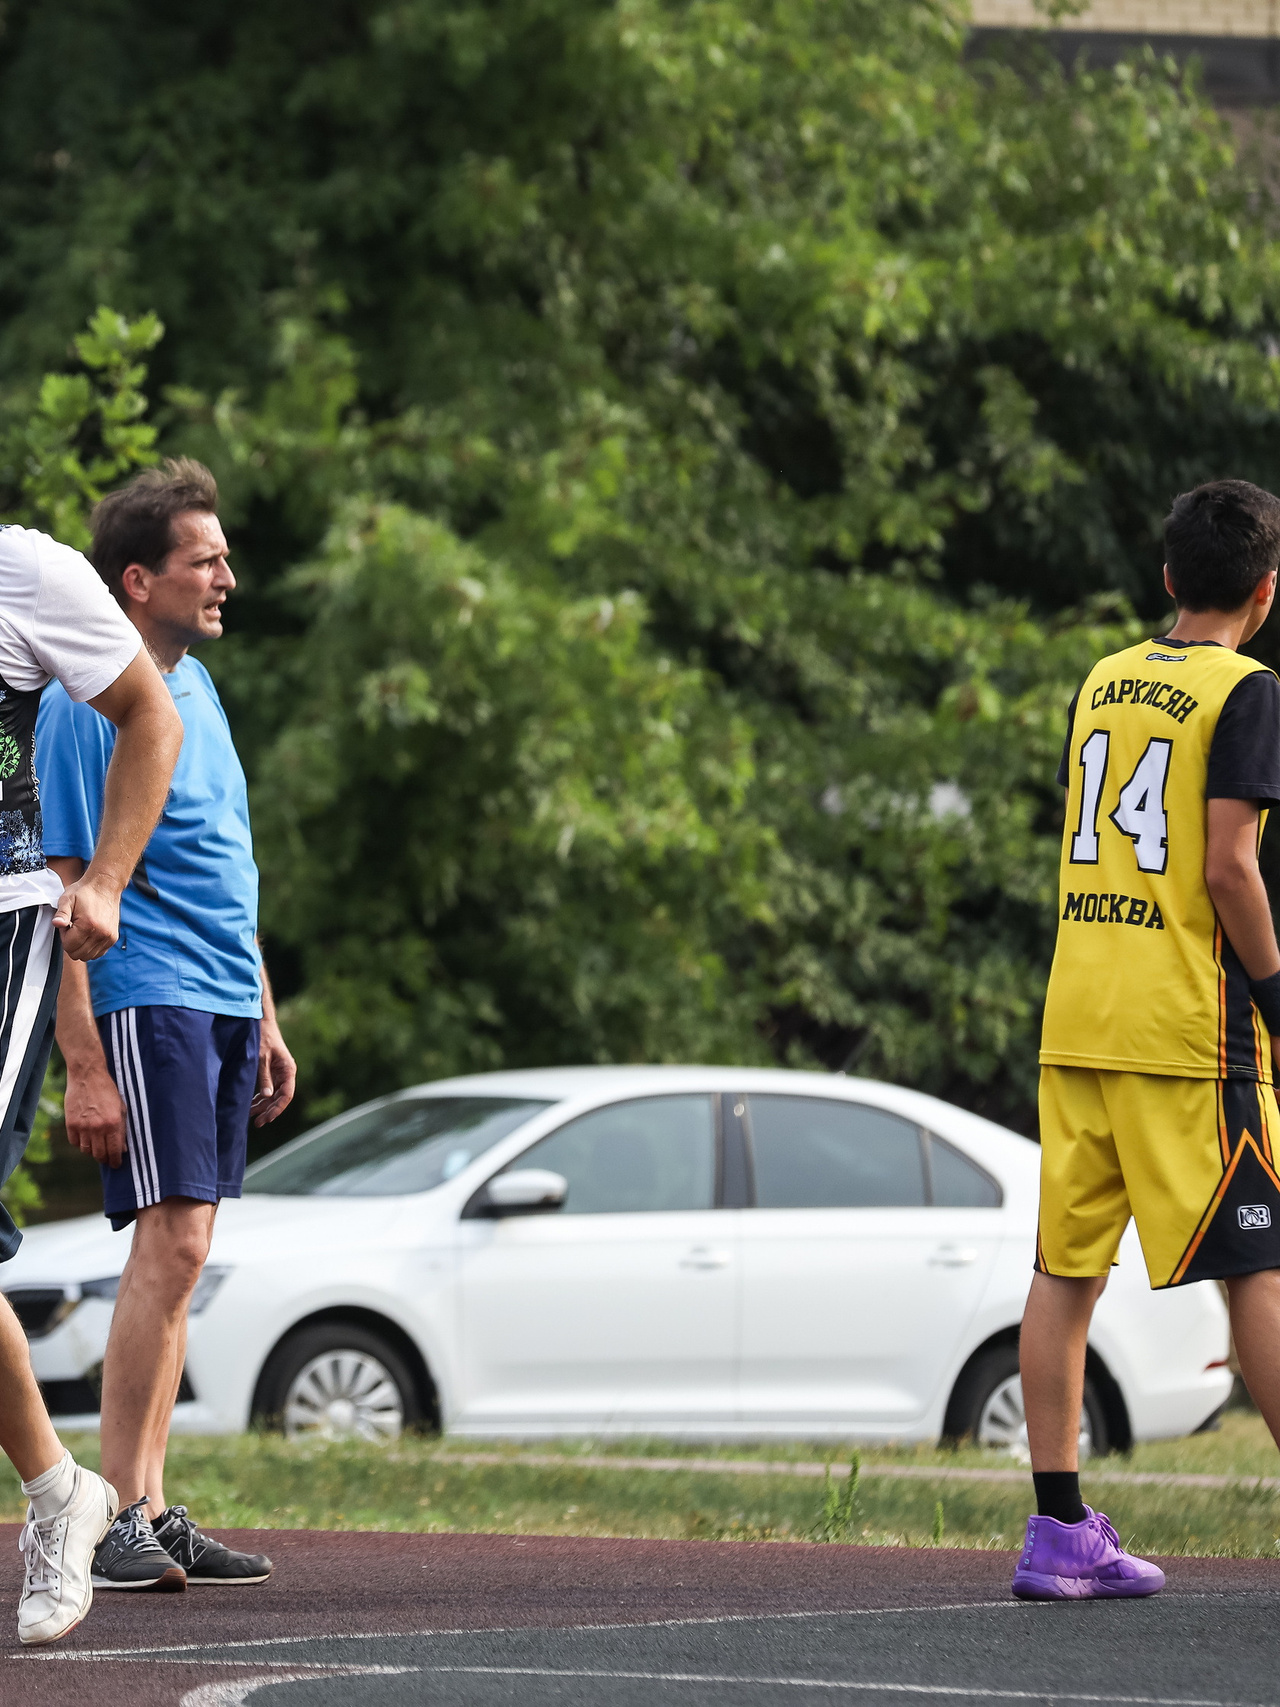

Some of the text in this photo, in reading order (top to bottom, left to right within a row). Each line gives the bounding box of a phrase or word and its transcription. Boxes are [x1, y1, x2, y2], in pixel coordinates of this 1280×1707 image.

[1091, 678, 1199, 724] САРКИСЯН
[1069, 728, 1174, 876] 14
[1062, 892, 1166, 930] МОСКВА
